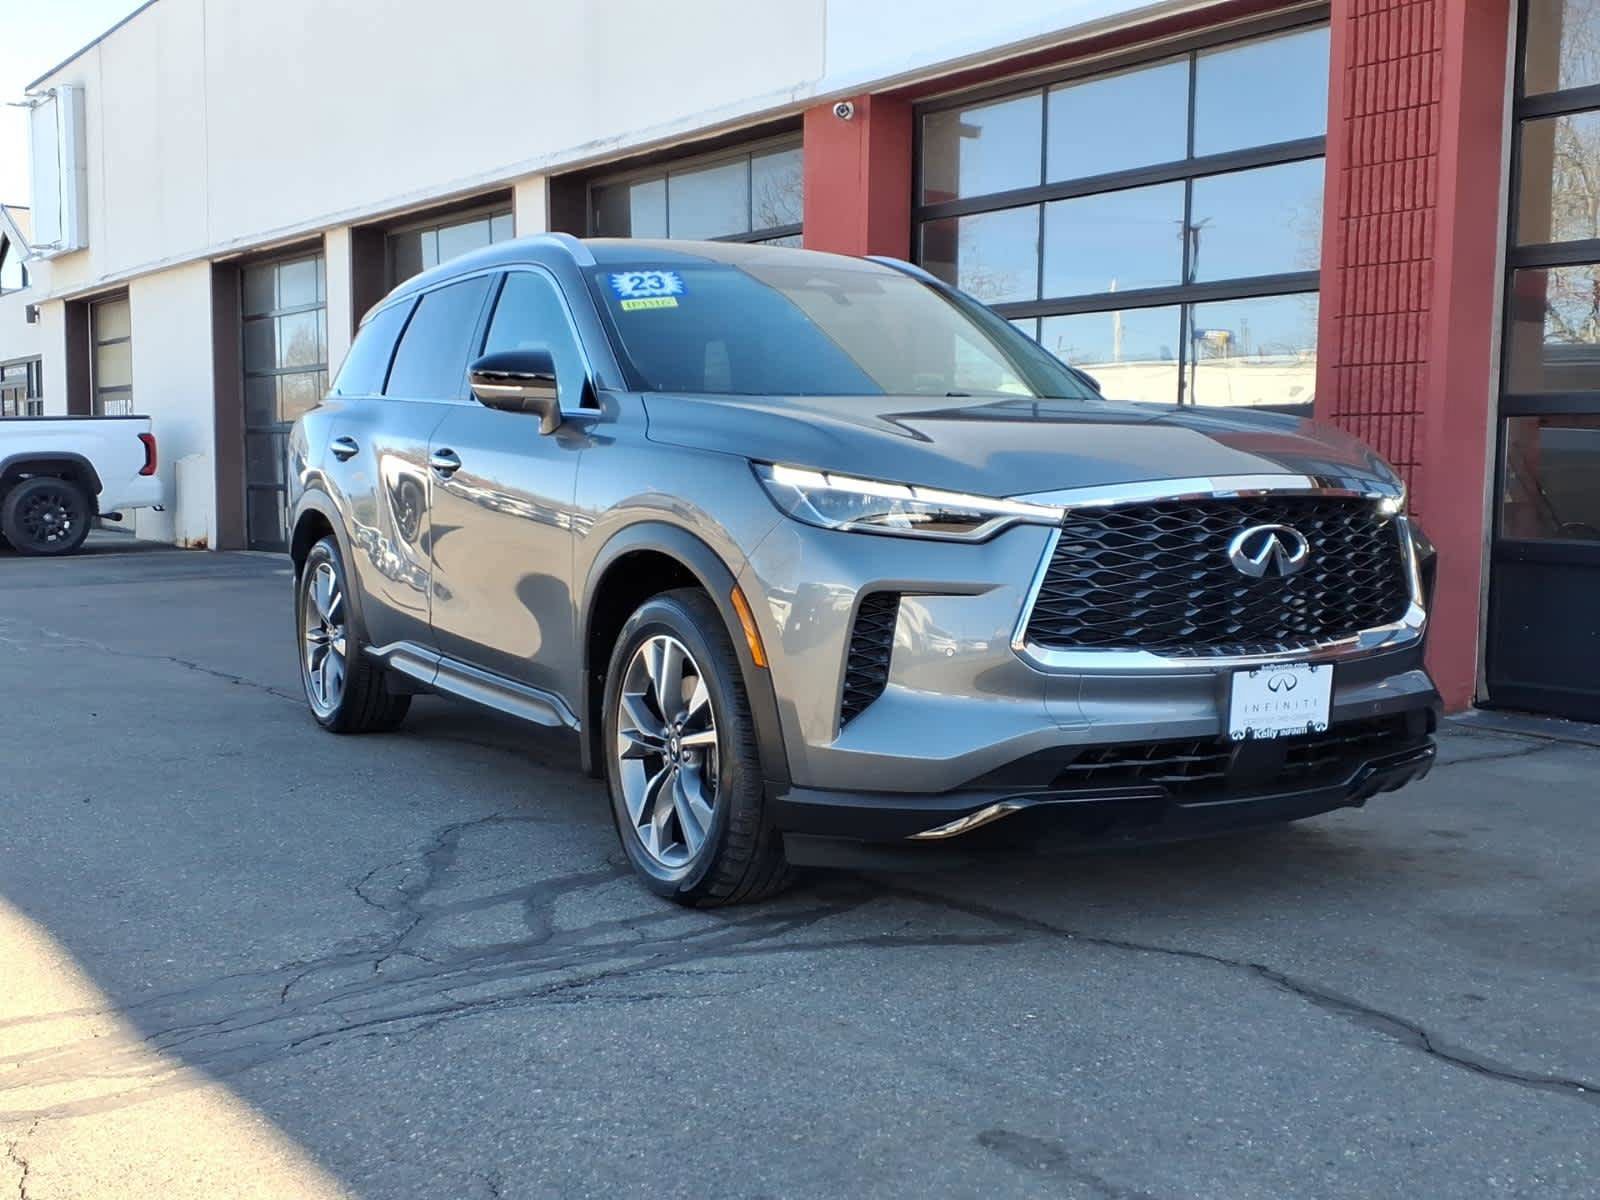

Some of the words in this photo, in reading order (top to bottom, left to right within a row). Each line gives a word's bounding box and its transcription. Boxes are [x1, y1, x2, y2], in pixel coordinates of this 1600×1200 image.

[629, 274, 665, 291] 23
[1244, 697, 1318, 713] INFINITI
[1253, 728, 1280, 740] Kelly
